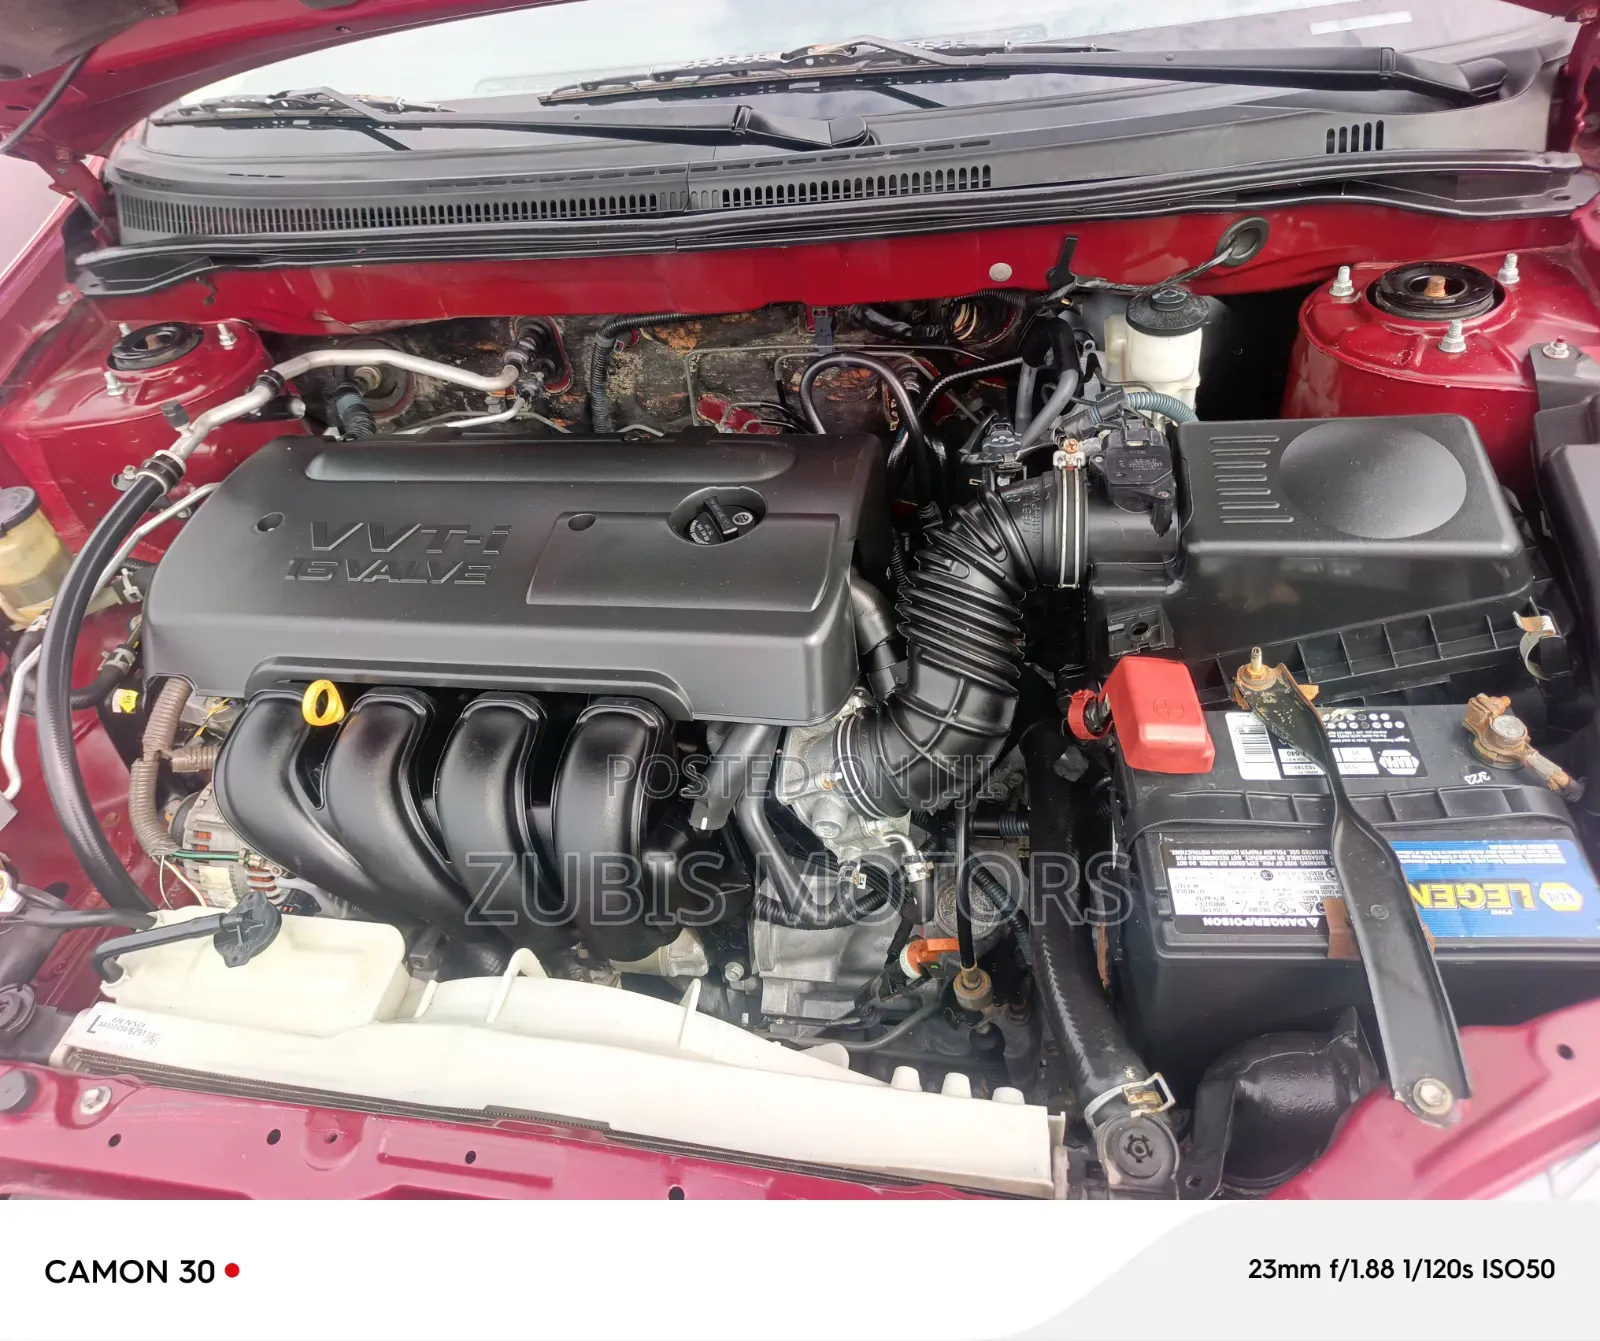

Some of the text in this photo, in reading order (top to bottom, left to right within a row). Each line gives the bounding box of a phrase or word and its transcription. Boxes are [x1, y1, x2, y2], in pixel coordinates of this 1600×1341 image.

[310, 521, 512, 555] VVT-i
[284, 557, 492, 585] 16 VALVE
[1463, 771, 1491, 785] 3/23
[1409, 880, 1536, 910] LEGEN
[1203, 917, 1307, 927] DANGER/POISON
[86, 1014, 102, 1035] L
